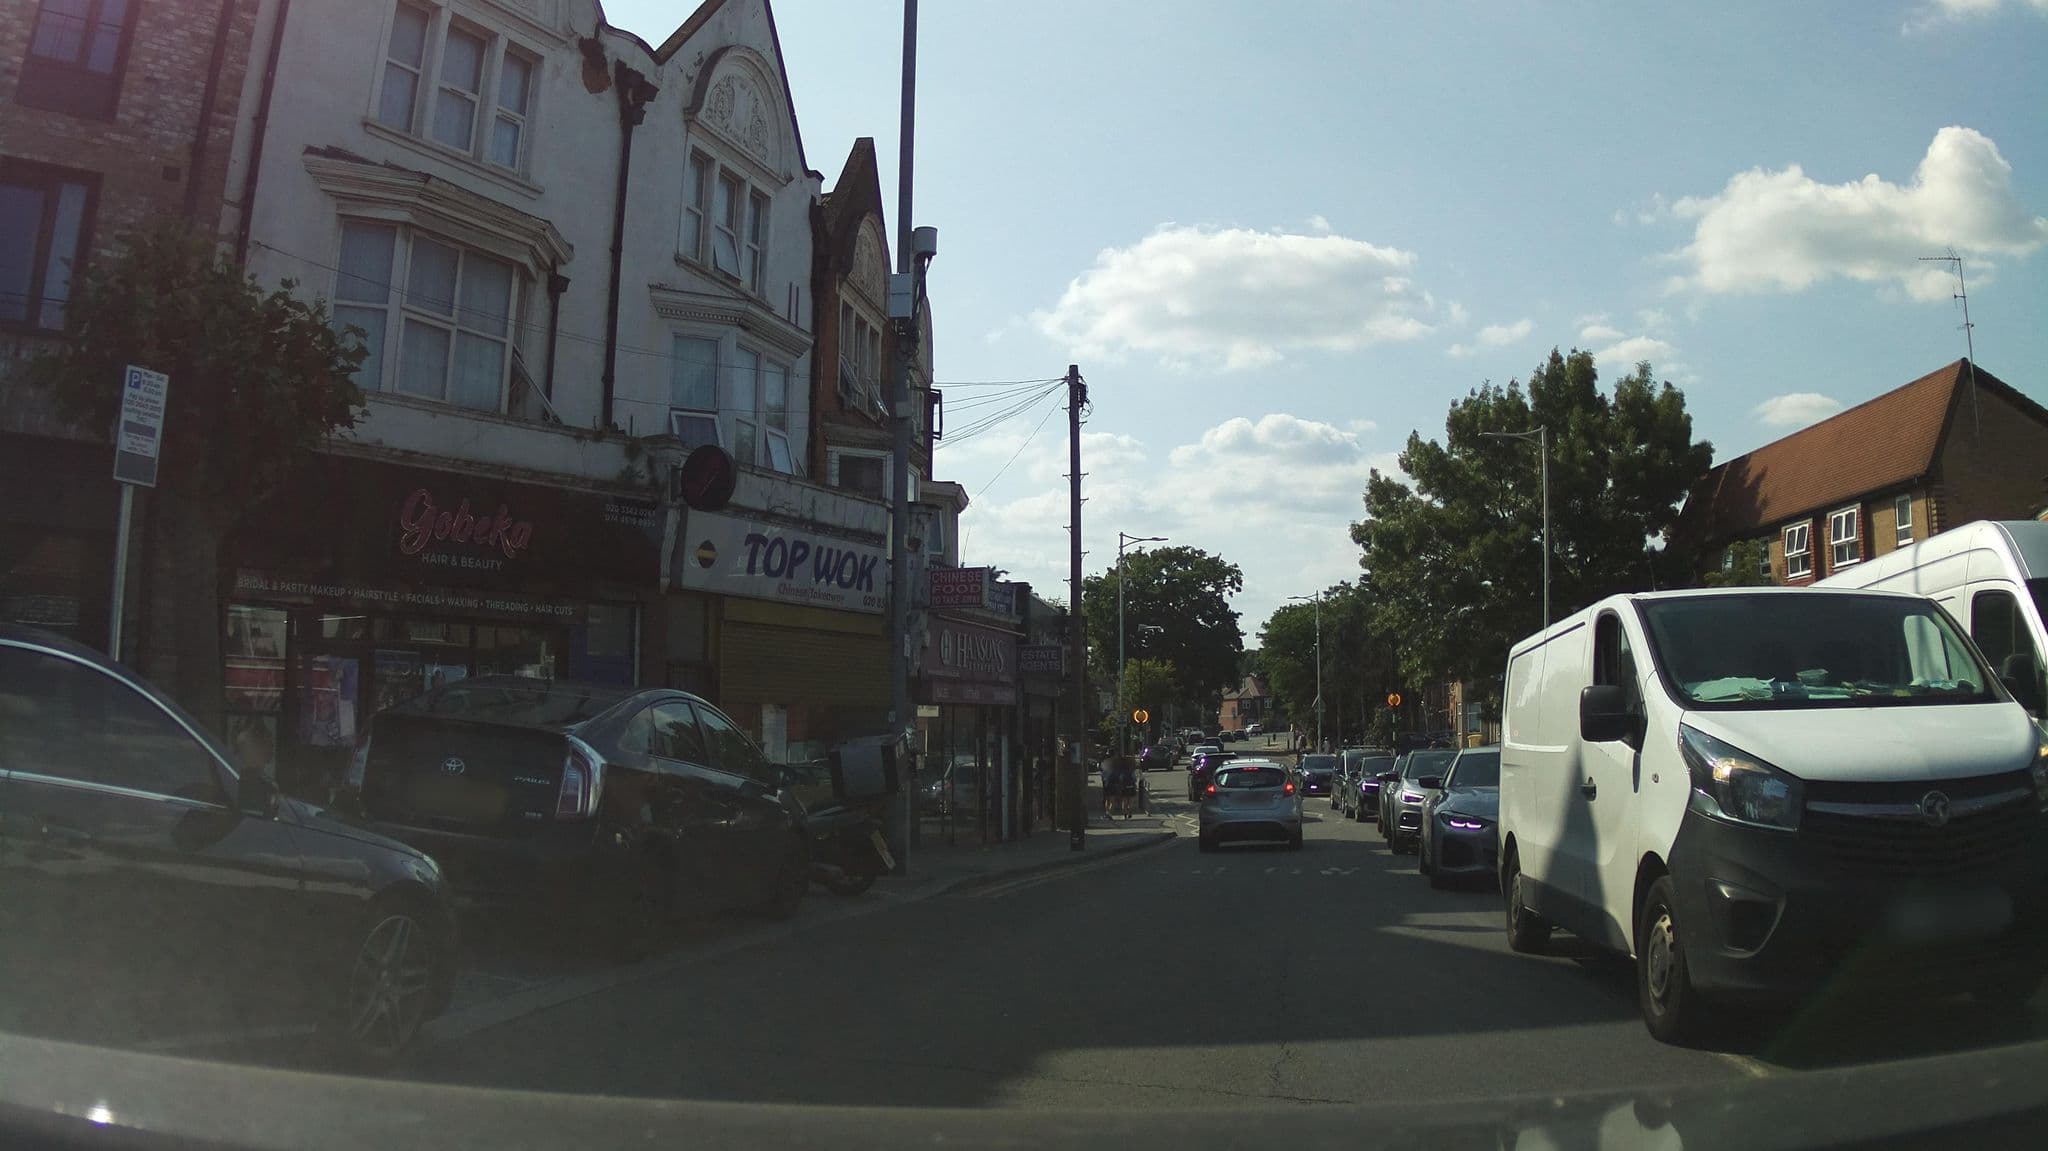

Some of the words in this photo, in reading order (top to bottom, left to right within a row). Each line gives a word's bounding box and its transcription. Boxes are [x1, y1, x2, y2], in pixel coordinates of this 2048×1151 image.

[421, 553, 448, 565] HAIR
[449, 556, 458, 567] &
[460, 557, 504, 571] BEAUTY
[744, 532, 811, 580] TOP
[813, 545, 879, 593] WOK
[931, 570, 982, 584] CHINESE
[237, 575, 272, 592] BRIDAL
[280, 581, 309, 595] PARTY
[309, 584, 347, 598] MAKEUP
[353, 588, 399, 602] HAIRSTYLE
[407, 592, 441, 606] FACIALS
[447, 597, 479, 609] WAXING
[485, 599, 529, 614] THREADING
[535, 604, 553, 615] HAIR
[553, 605, 574, 617] CUTS
[932, 584, 982, 595] FOOD
[1022, 649, 1059, 660] ESTATE
[1019, 660, 1062, 672] AGENTS
